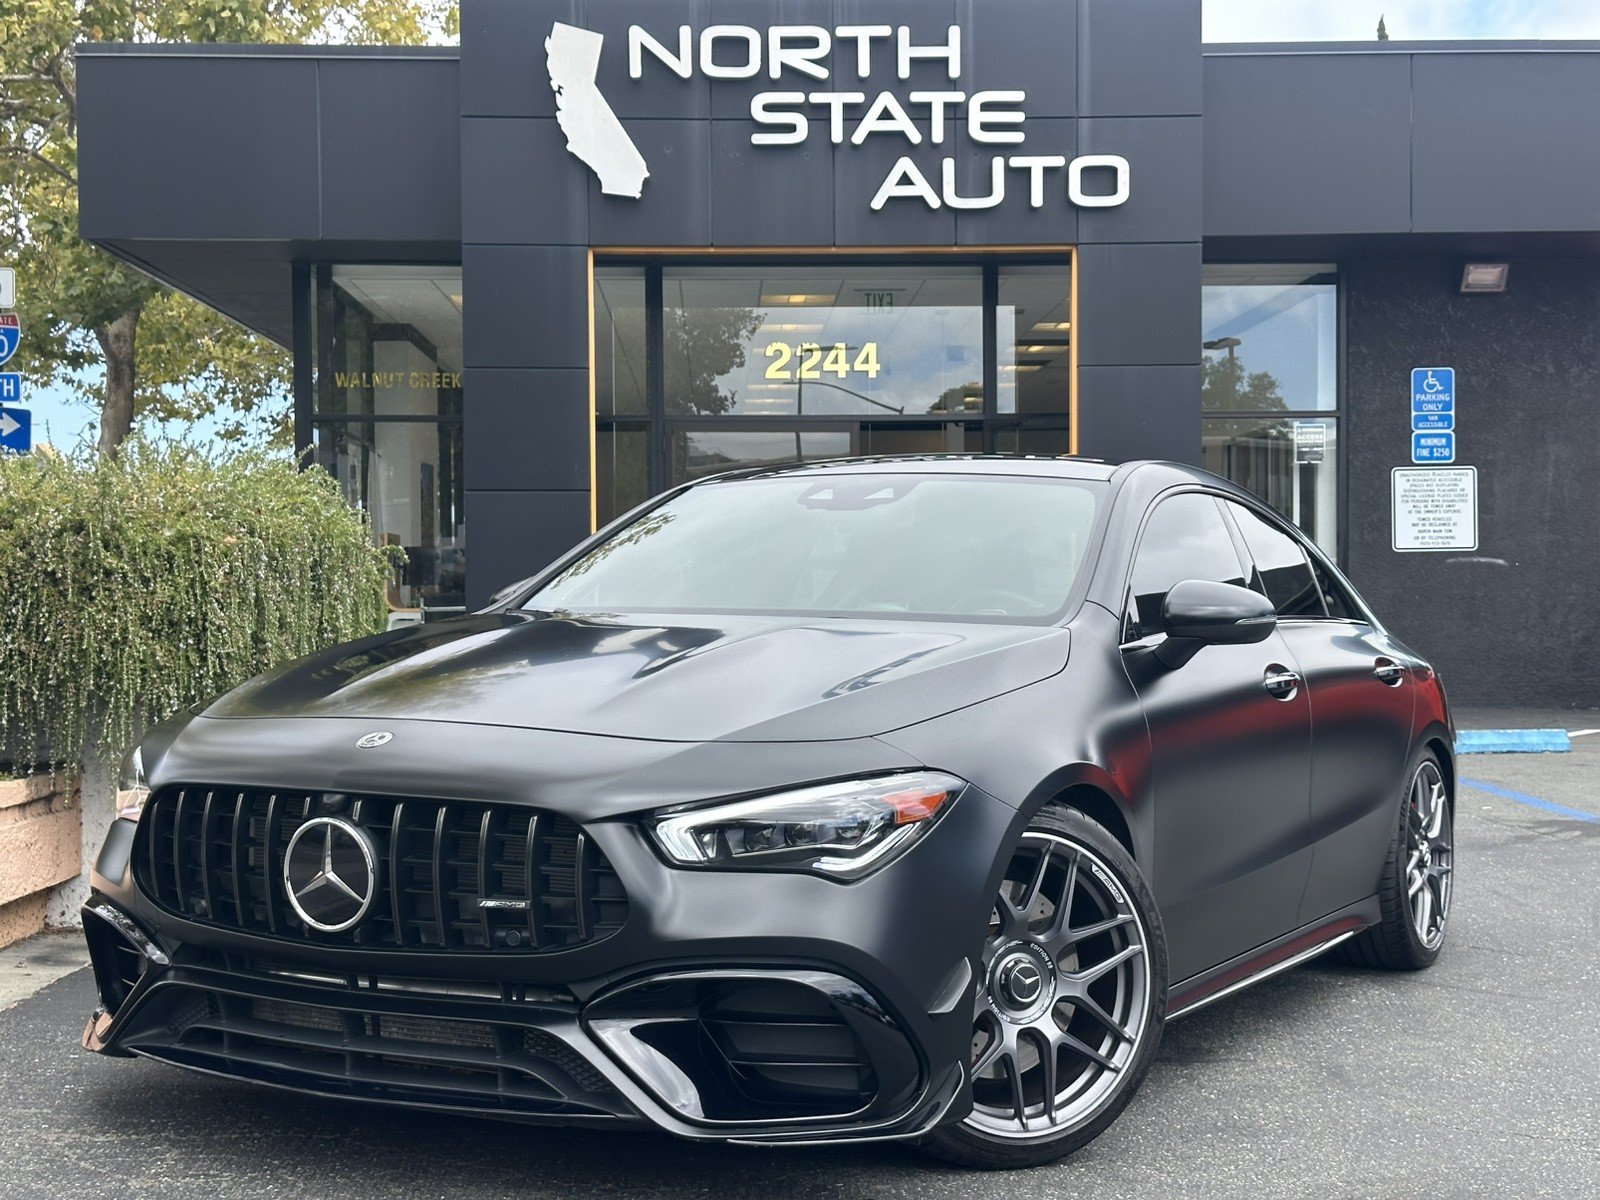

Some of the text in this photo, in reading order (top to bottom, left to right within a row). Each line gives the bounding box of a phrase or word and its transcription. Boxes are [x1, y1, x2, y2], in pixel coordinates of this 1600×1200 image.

[628, 24, 961, 80] NORTH
[750, 90, 1026, 145] STATE
[870, 154, 1131, 210] AUTO
[764, 342, 881, 379] 2244
[334, 372, 462, 388] WALNUT CREEK
[1416, 448, 1450, 457] FINE $250
[1420, 437, 1446, 446] MINIMUM
[1029, 943, 1050, 961] EDITION
